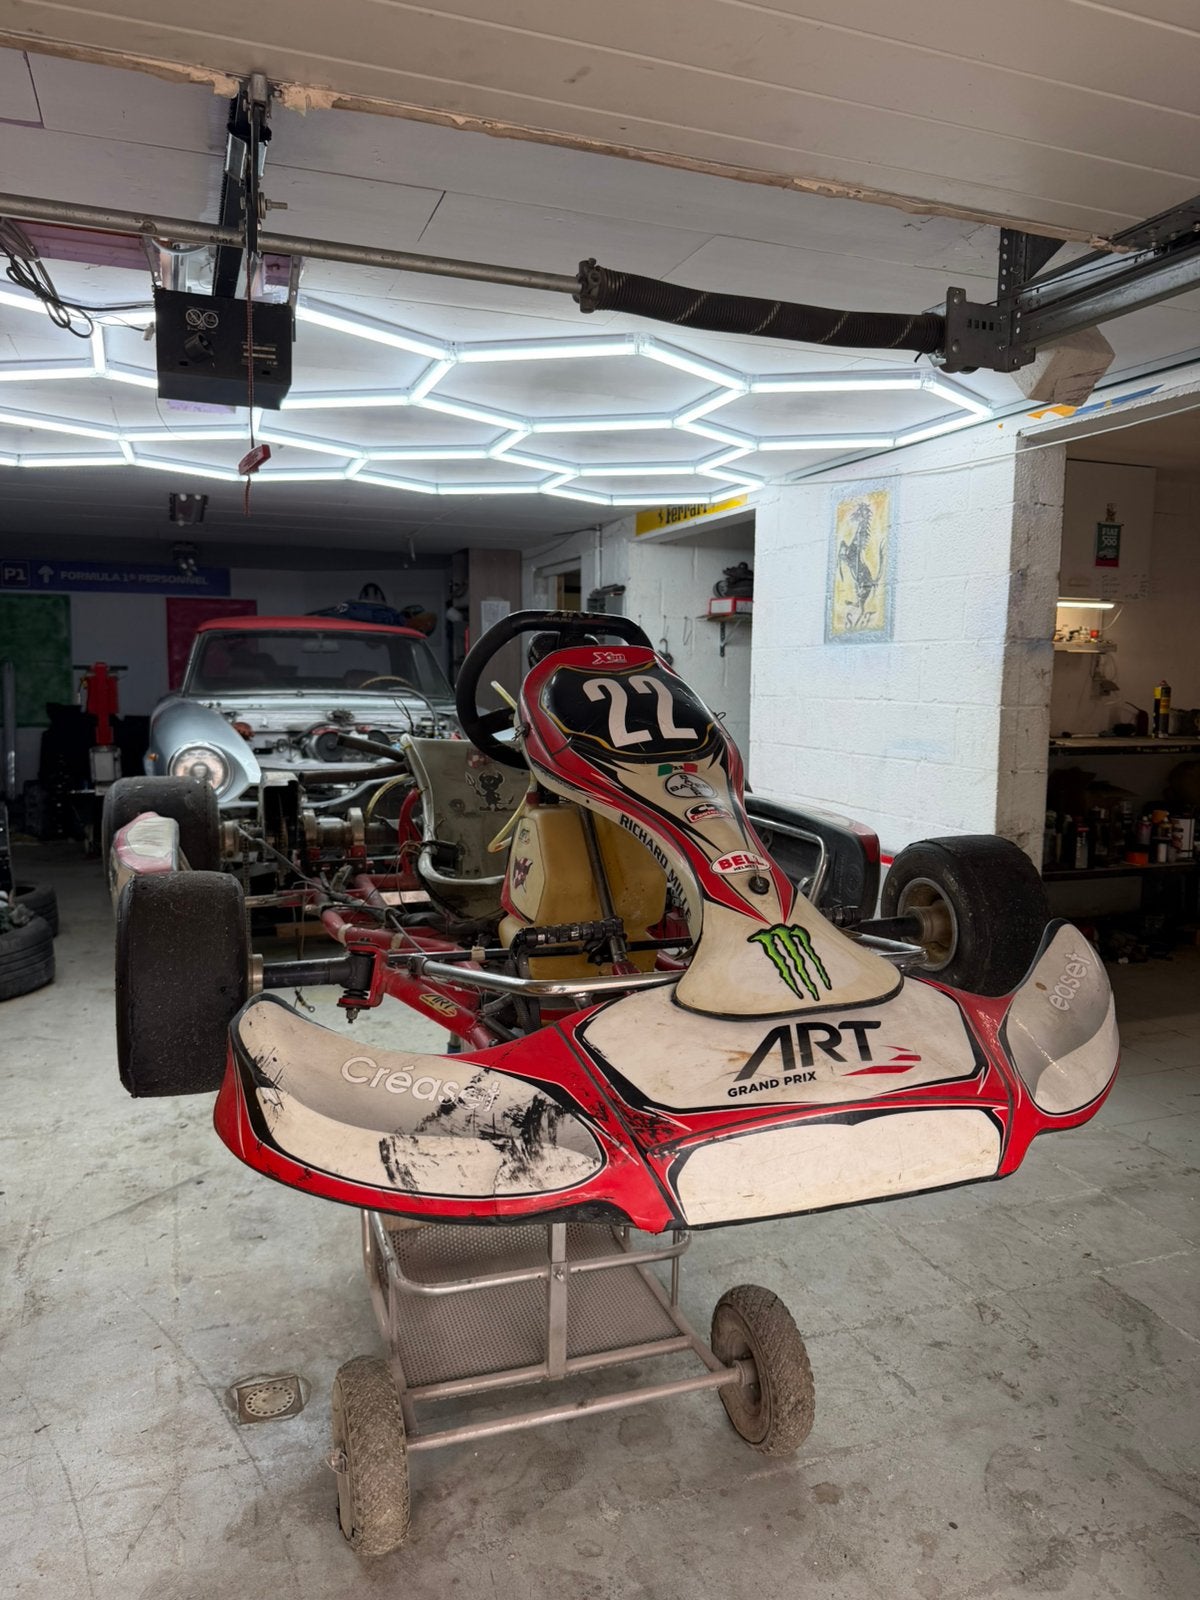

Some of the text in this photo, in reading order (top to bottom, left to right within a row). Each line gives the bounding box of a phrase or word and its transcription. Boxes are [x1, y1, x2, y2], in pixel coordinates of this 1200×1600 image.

[4, 566, 27, 582] P1
[60, 570, 120, 583] FORMULA
[137, 574, 209, 586] PERSONNEL
[582, 674, 699, 748] 22
[619, 812, 692, 919] RICHARD MILLE
[717, 854, 766, 872] BELL
[733, 1020, 882, 1082] ART
[341, 1056, 500, 1112] Créaset
[727, 1071, 817, 1098] GRAND PRIX
